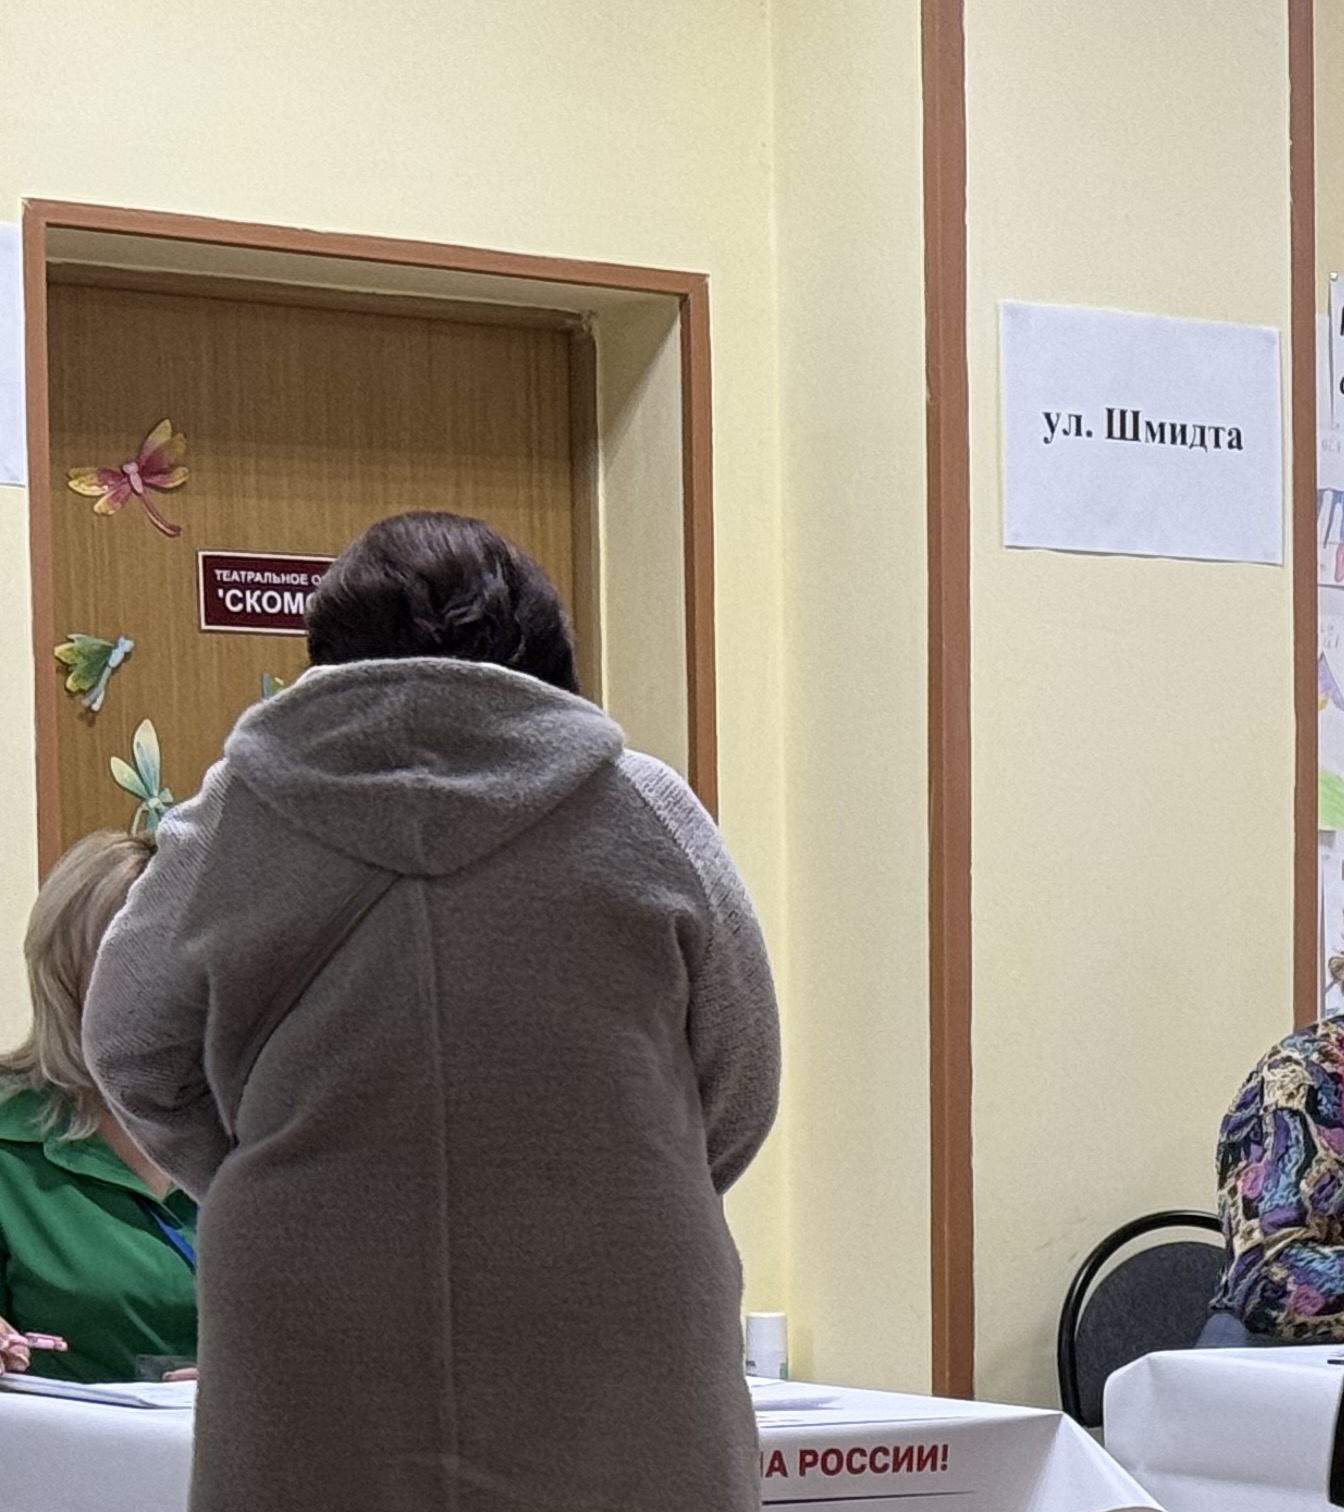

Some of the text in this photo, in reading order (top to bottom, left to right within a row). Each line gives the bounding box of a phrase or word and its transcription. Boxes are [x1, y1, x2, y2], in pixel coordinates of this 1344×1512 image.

[1042, 407, 1243, 453] ул. Шмидта
[214, 569, 309, 585] ТЕАТРАЛЬНОЕ
[760, 1443, 949, 1478] А РОССИИ!
